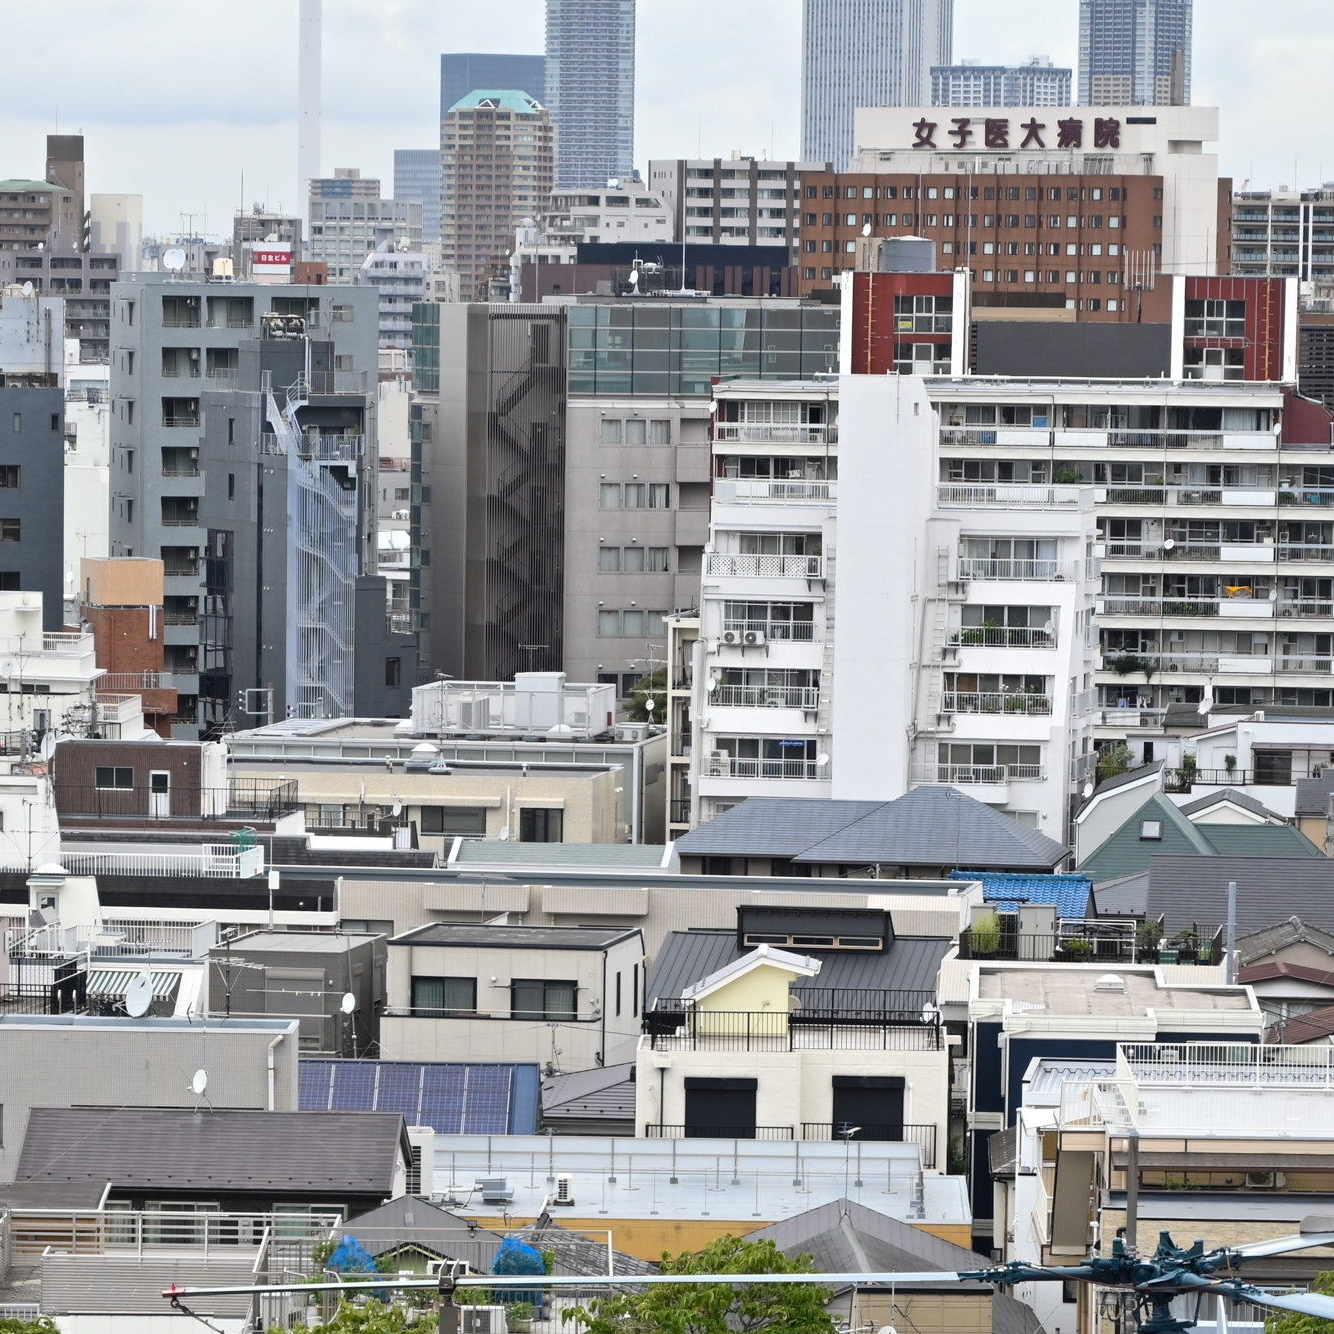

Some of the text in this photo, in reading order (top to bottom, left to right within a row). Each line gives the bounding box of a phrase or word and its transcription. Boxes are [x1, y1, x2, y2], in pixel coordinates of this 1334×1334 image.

[912, 116, 1121, 149] 女子医大病院
